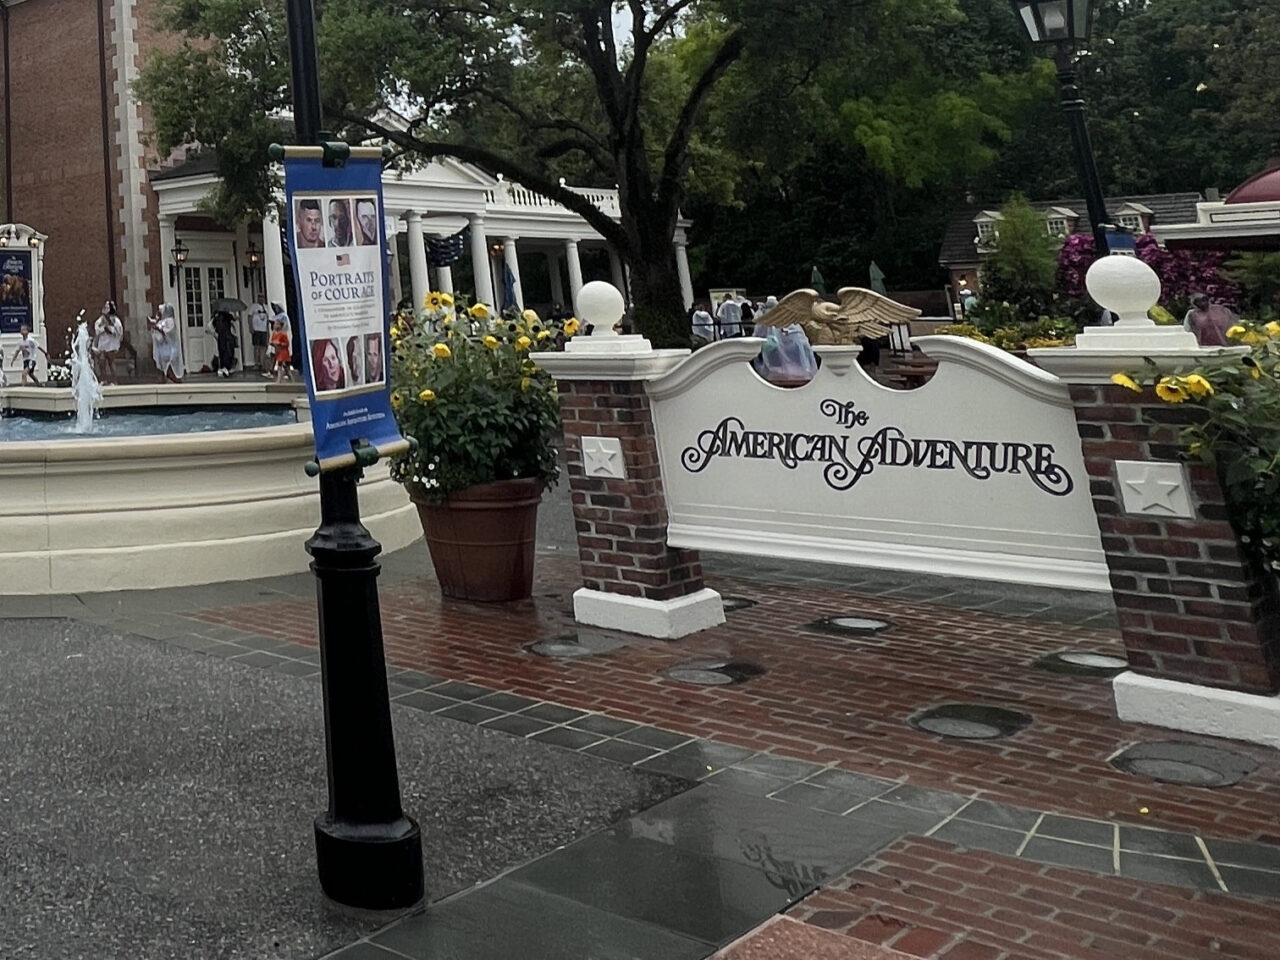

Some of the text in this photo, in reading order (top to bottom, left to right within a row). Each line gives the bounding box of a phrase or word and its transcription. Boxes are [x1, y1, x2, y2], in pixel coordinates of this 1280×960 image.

[310, 270, 375, 288] PORTRAITS
[311, 291, 323, 301] OF
[820, 398, 870, 428] The
[681, 417, 1074, 496] AMERICAN ADVENTURE
